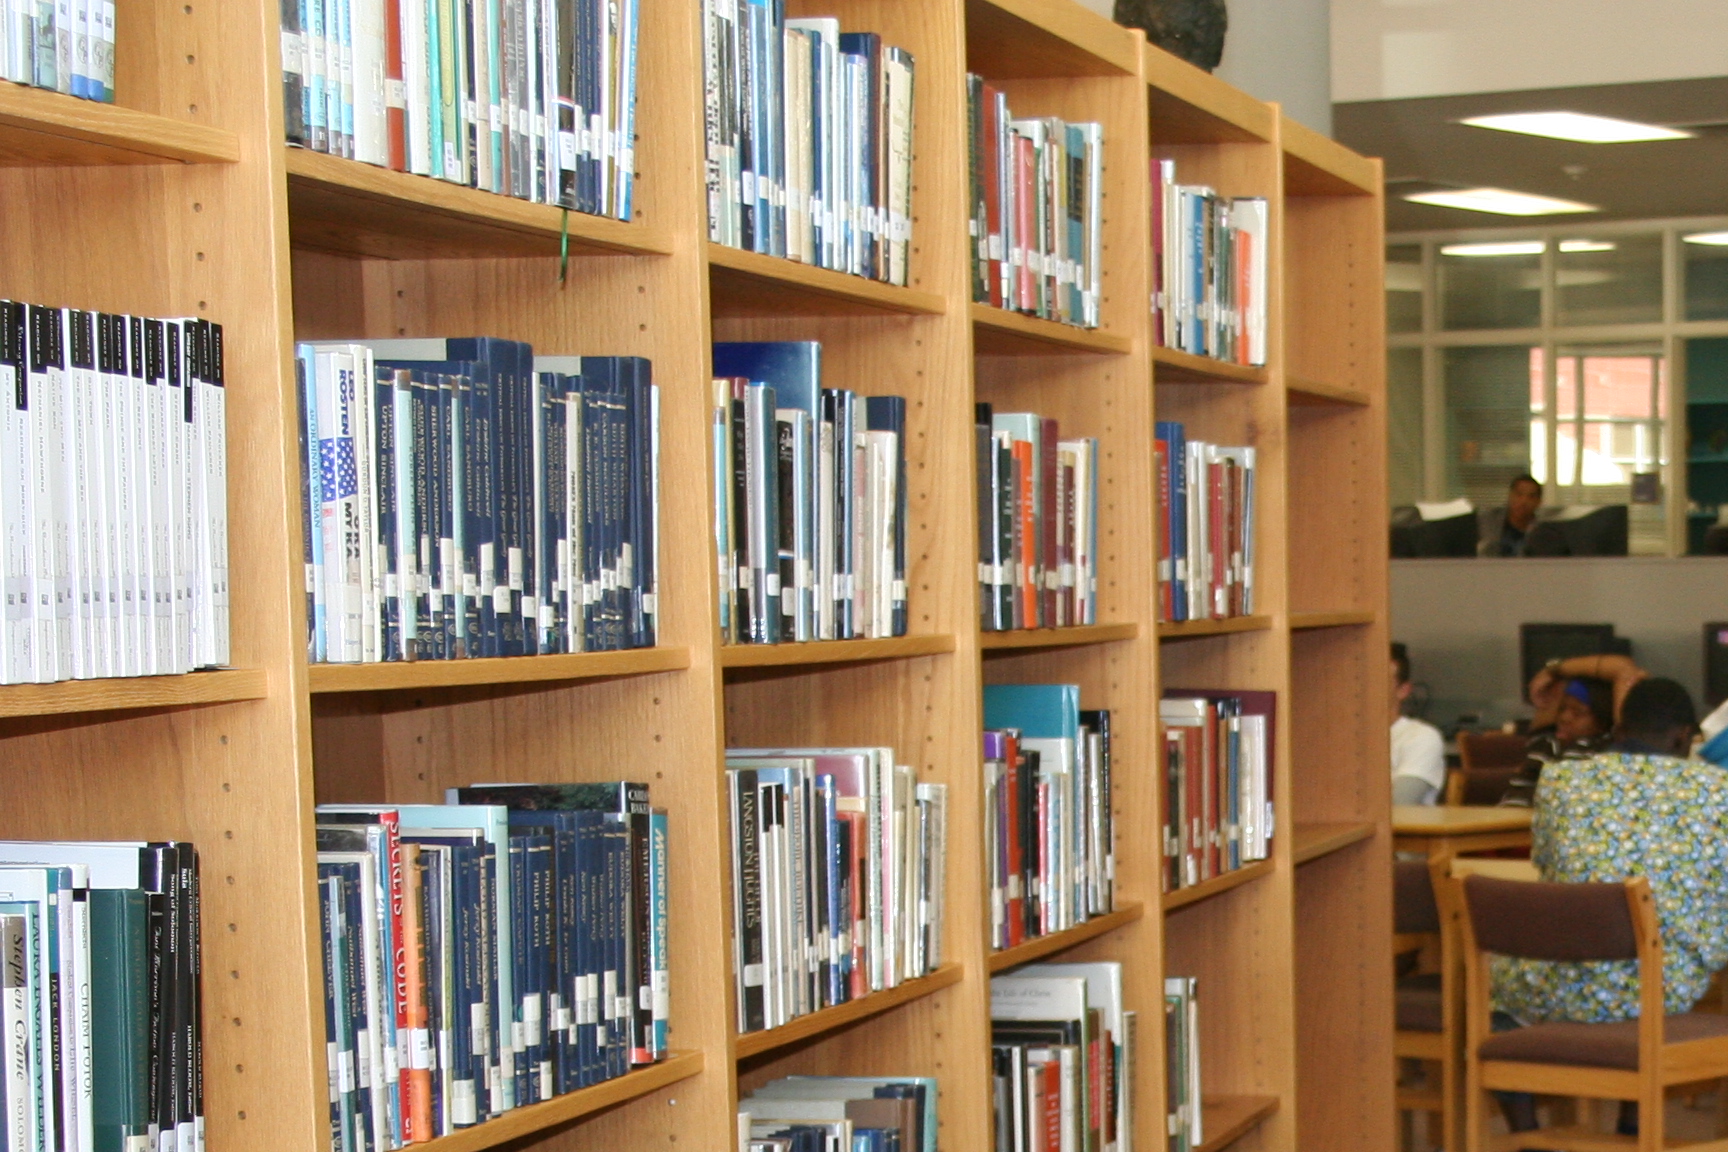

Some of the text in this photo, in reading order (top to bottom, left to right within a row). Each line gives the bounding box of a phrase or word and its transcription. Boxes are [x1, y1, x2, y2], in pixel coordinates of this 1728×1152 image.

[339, 368, 349, 435] ROSTEN
[654, 828, 665, 897] Manner
[656, 918, 667, 970] Speak
[8, 934, 26, 1082] Stephen Crane
[396, 946, 408, 1015] CODE
[52, 1017, 60, 1072] LONDON
